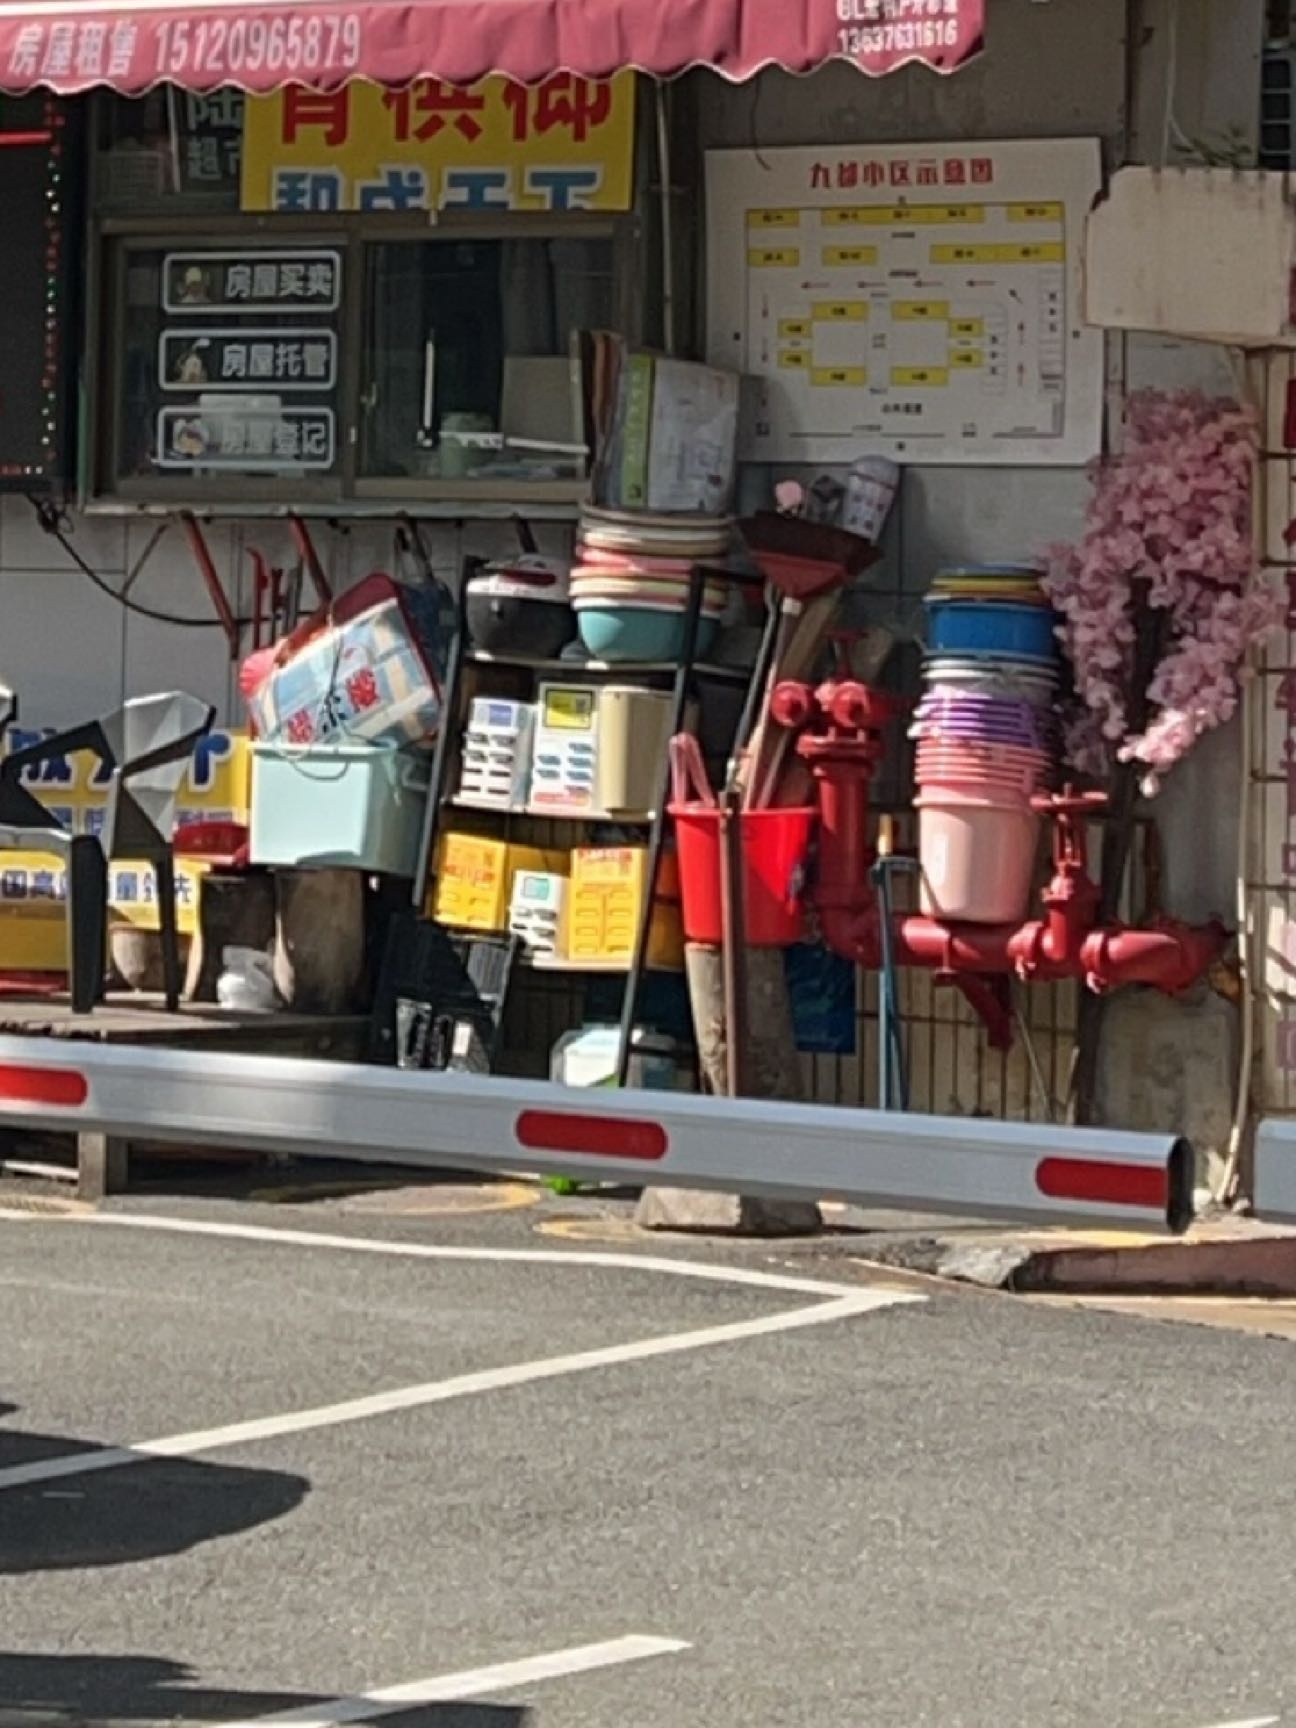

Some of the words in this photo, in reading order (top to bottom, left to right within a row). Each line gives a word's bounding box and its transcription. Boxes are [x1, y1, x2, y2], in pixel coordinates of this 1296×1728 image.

[8, 19, 137, 78] 房屋租售
[154, 14, 362, 72] 15120965879
[226, 264, 333, 298] 房屋买卖
